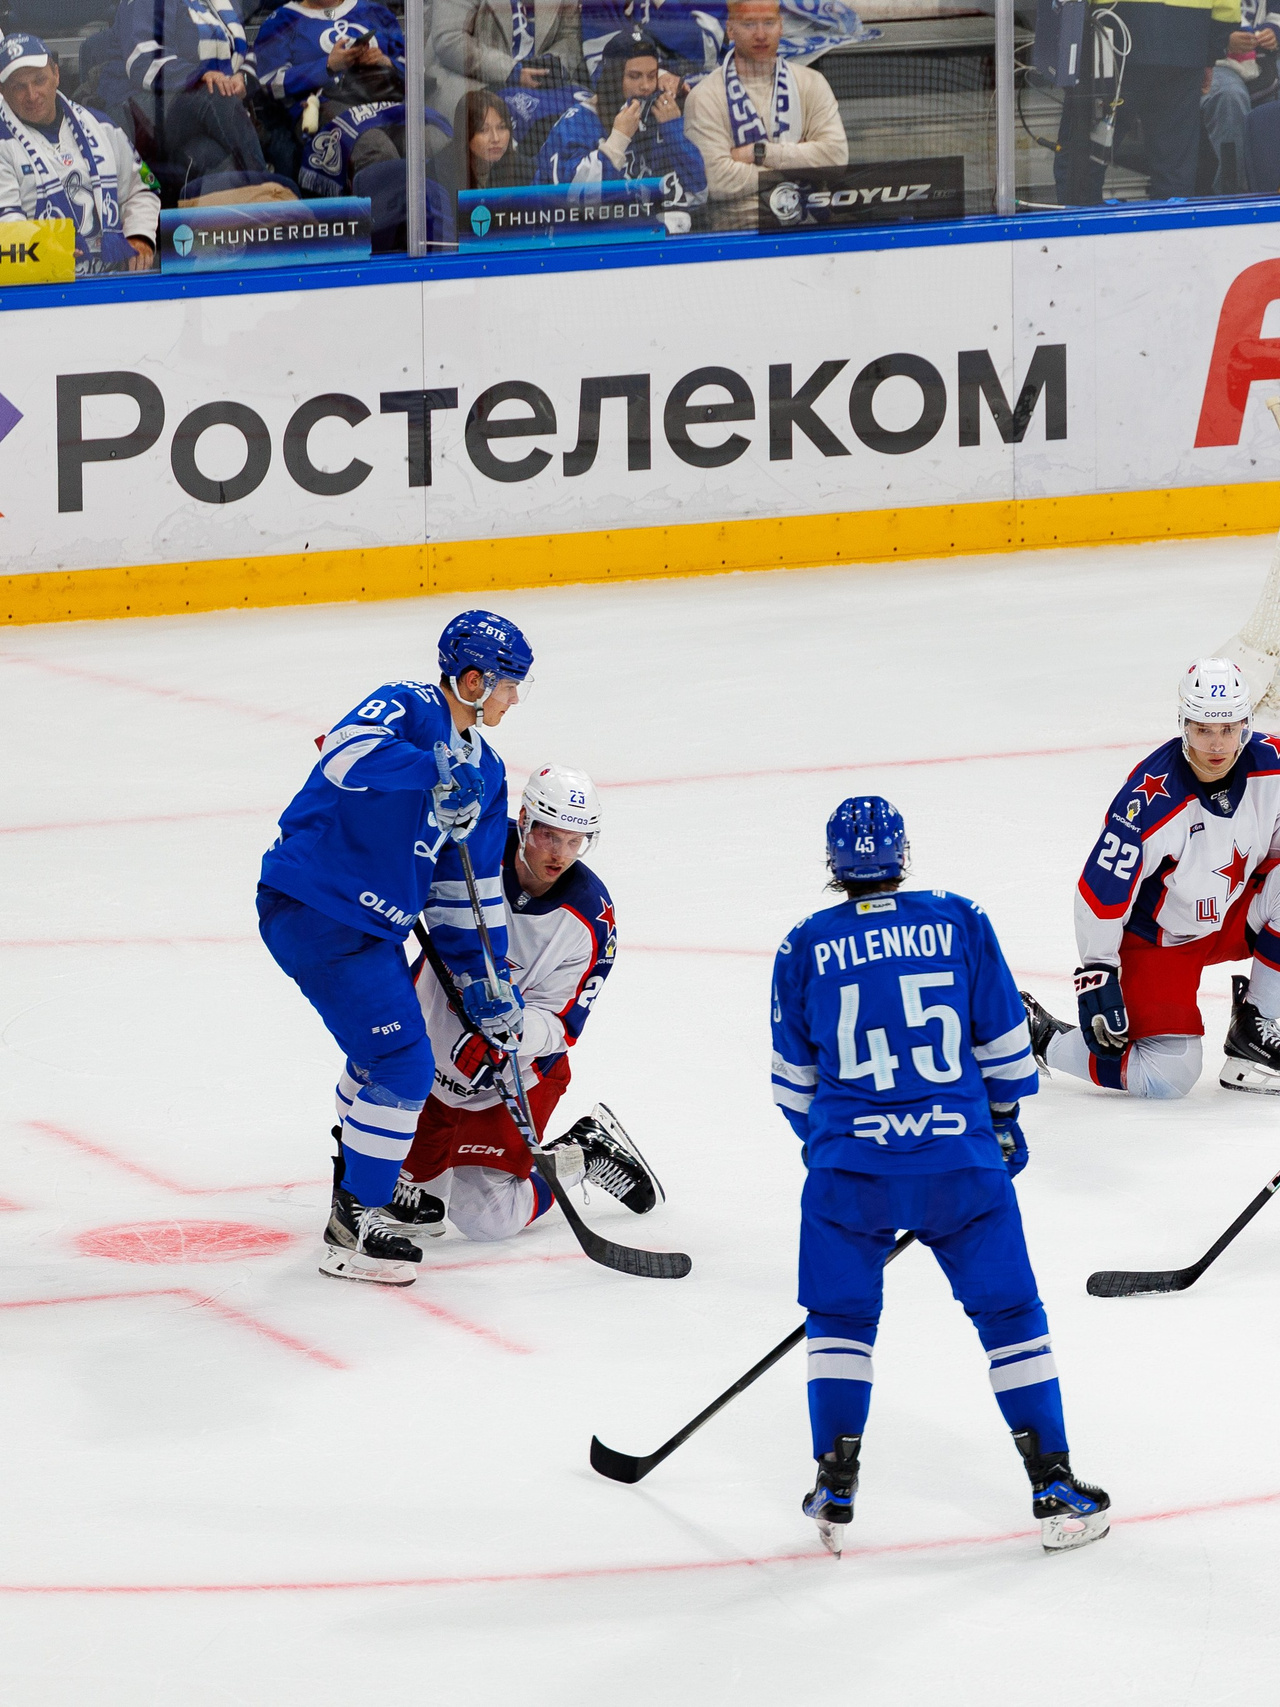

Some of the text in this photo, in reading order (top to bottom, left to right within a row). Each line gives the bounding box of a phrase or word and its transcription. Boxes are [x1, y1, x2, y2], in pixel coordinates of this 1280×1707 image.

[806, 183, 931, 208] SOYUZ
[495, 202, 654, 227] THUNDEROBOT
[198, 221, 359, 246] THUNDEROBOT
[55, 343, 1068, 514] Ростелеком
[1210, 684, 1227, 698] 22
[357, 699, 407, 726] 87
[855, 836, 875, 853] 45
[1096, 831, 1140, 880] 22
[814, 923, 953, 976] PYLENKOV
[381, 1021, 402, 1035] ВТБ
[838, 971, 963, 1092] 45
[457, 1144, 506, 1157] CCM
